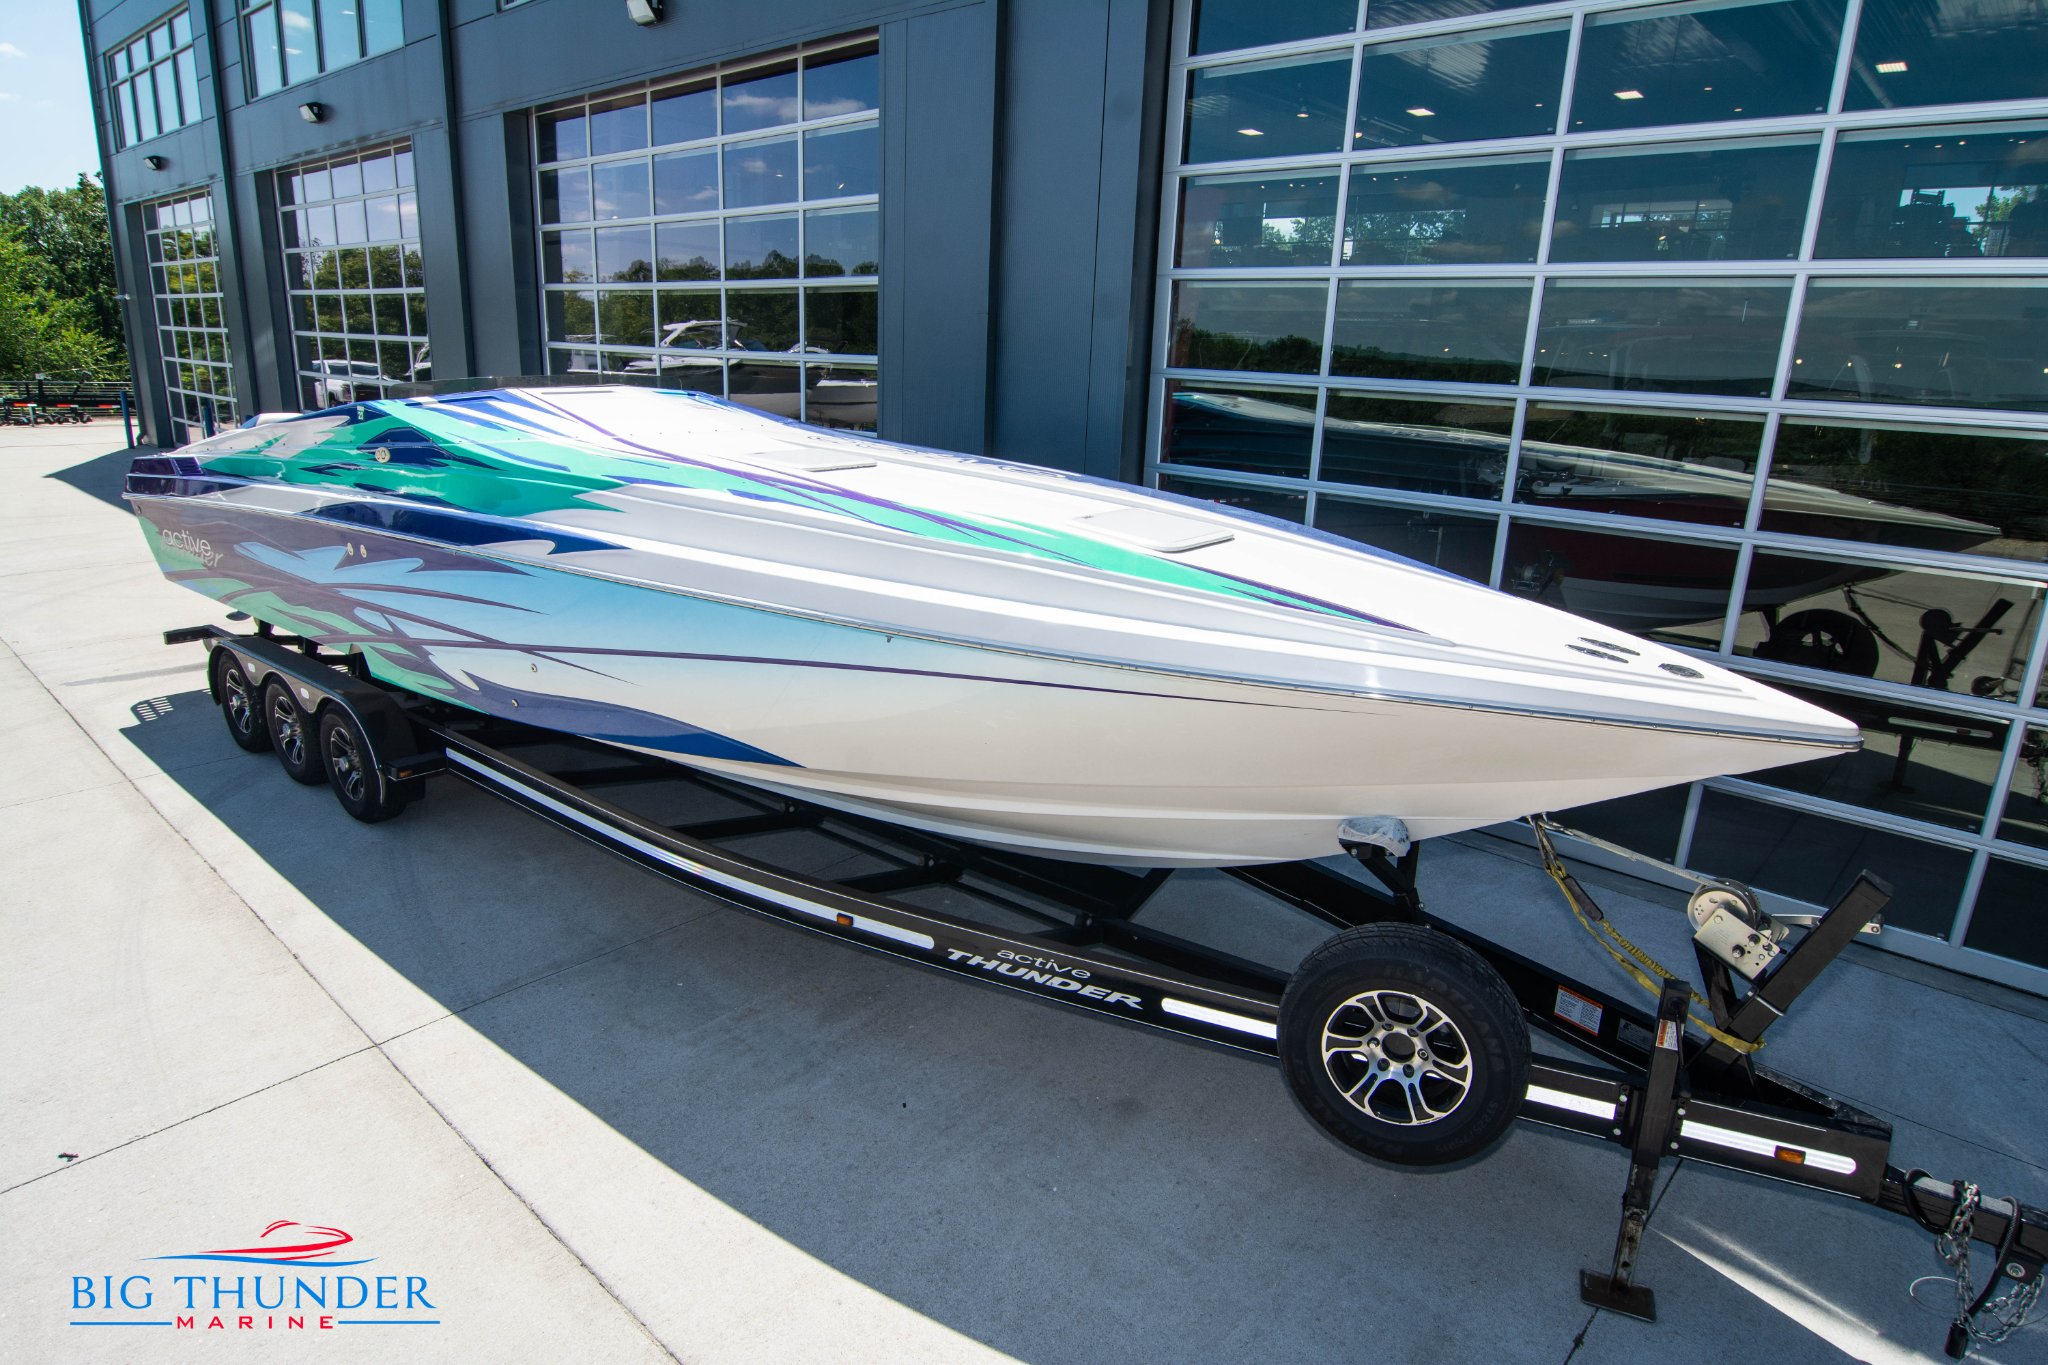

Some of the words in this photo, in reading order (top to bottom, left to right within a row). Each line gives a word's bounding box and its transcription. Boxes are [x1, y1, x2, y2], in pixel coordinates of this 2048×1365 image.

[162, 528, 211, 556] active
[947, 948, 1144, 1010] THUNDER
[996, 949, 1091, 979] active
